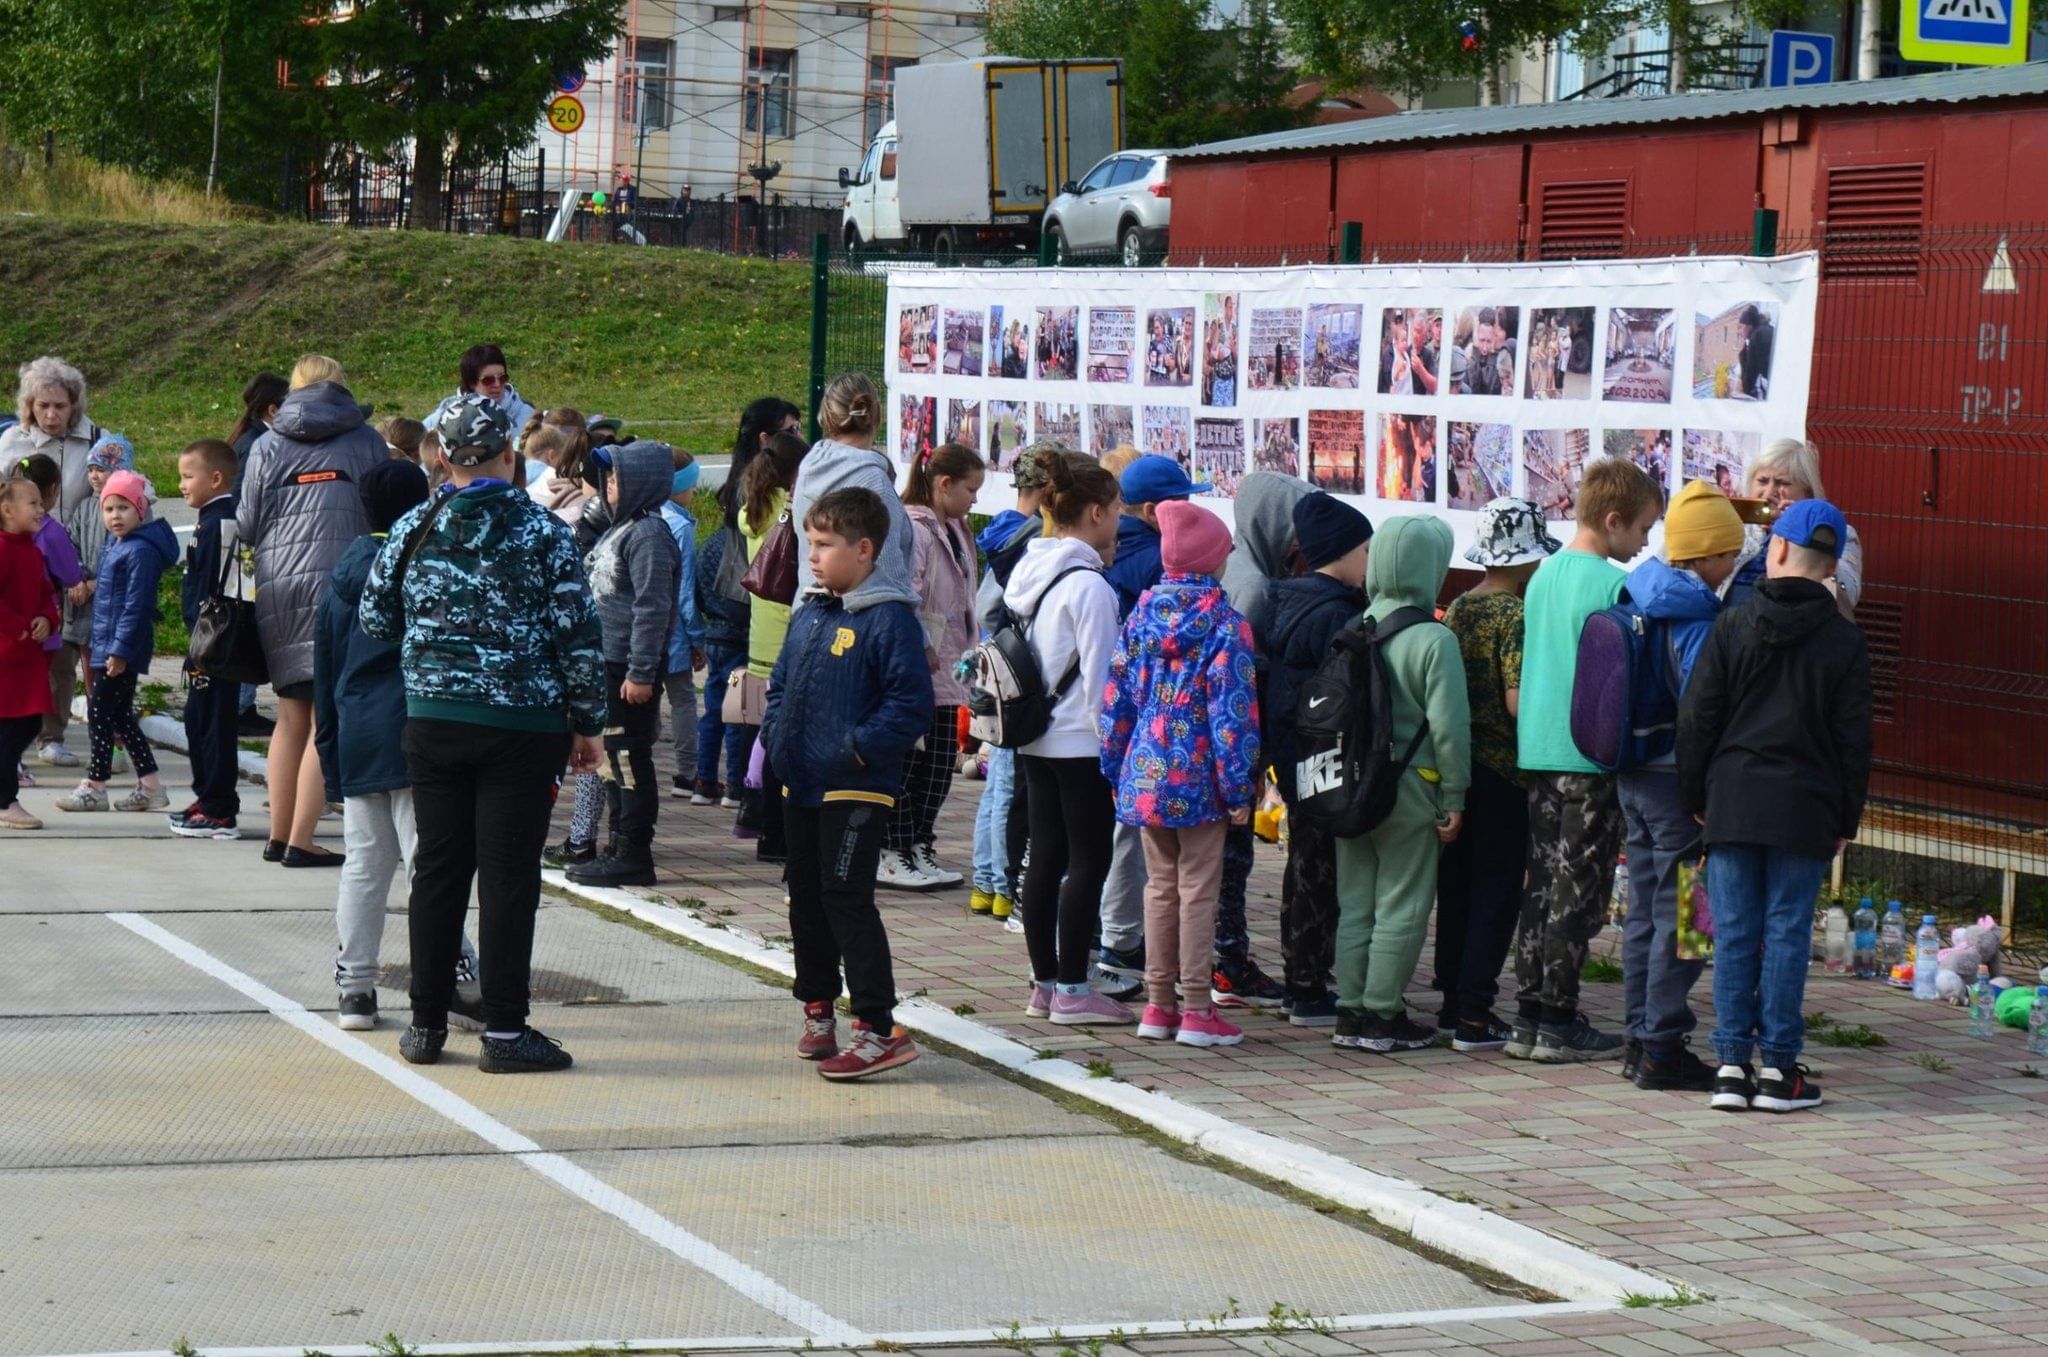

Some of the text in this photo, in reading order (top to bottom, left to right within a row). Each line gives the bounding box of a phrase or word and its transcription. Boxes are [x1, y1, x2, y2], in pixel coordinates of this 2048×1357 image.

[1786, 40, 1822, 88] P
[556, 107, 578, 123] 20
[831, 627, 856, 656] P
